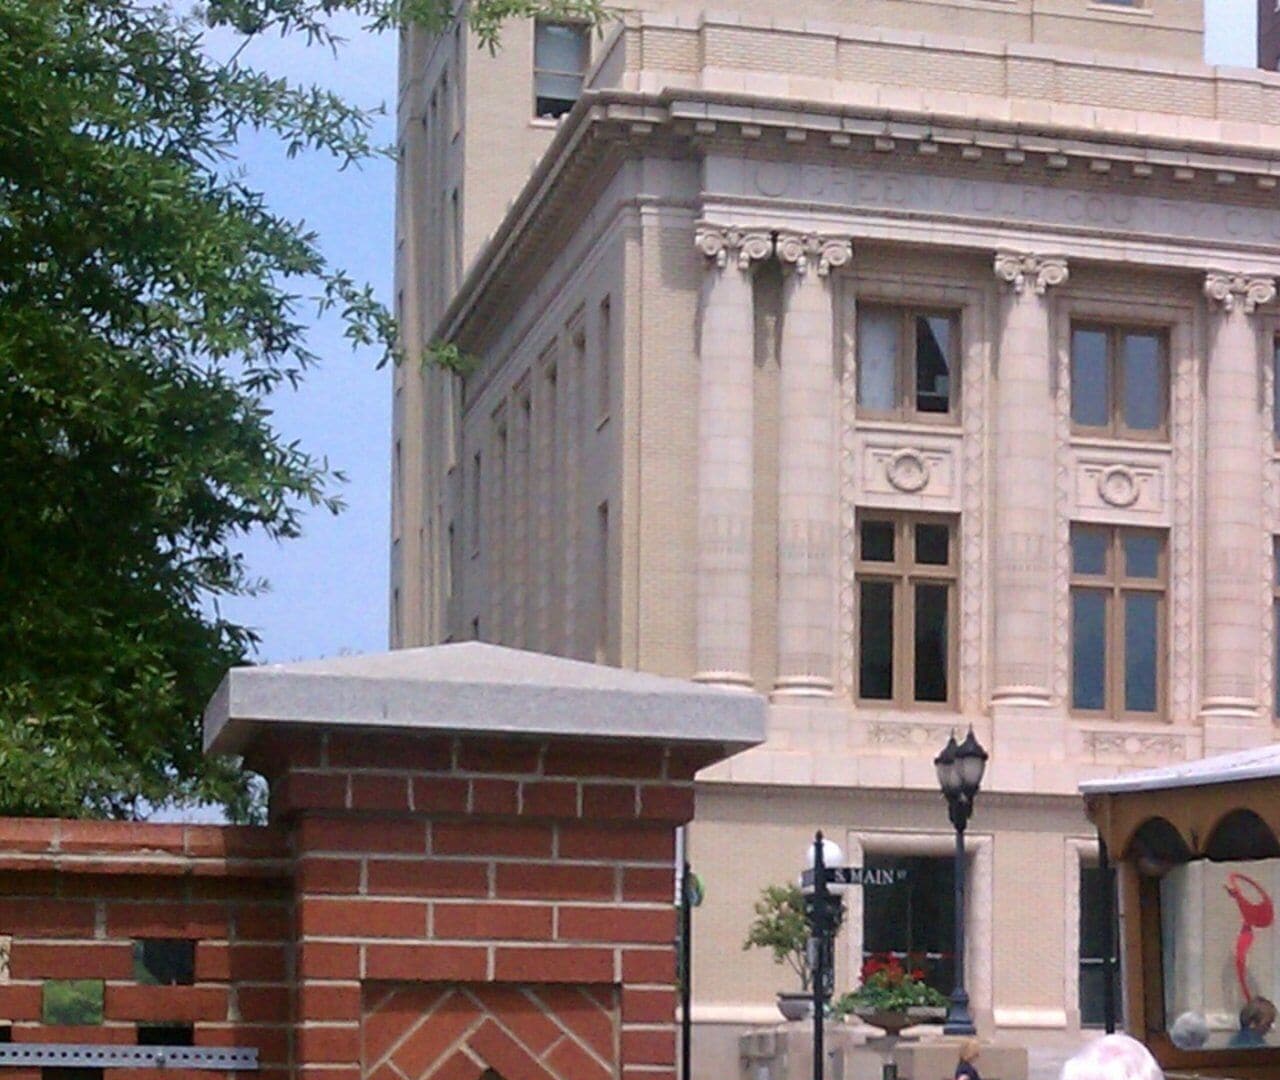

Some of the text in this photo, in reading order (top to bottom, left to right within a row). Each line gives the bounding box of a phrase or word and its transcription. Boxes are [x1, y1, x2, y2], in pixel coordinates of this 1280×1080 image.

[801, 162, 1042, 219] GREENVILLE
[1063, 194, 1213, 233] COUNTY
[850, 869, 894, 885] MAIN
